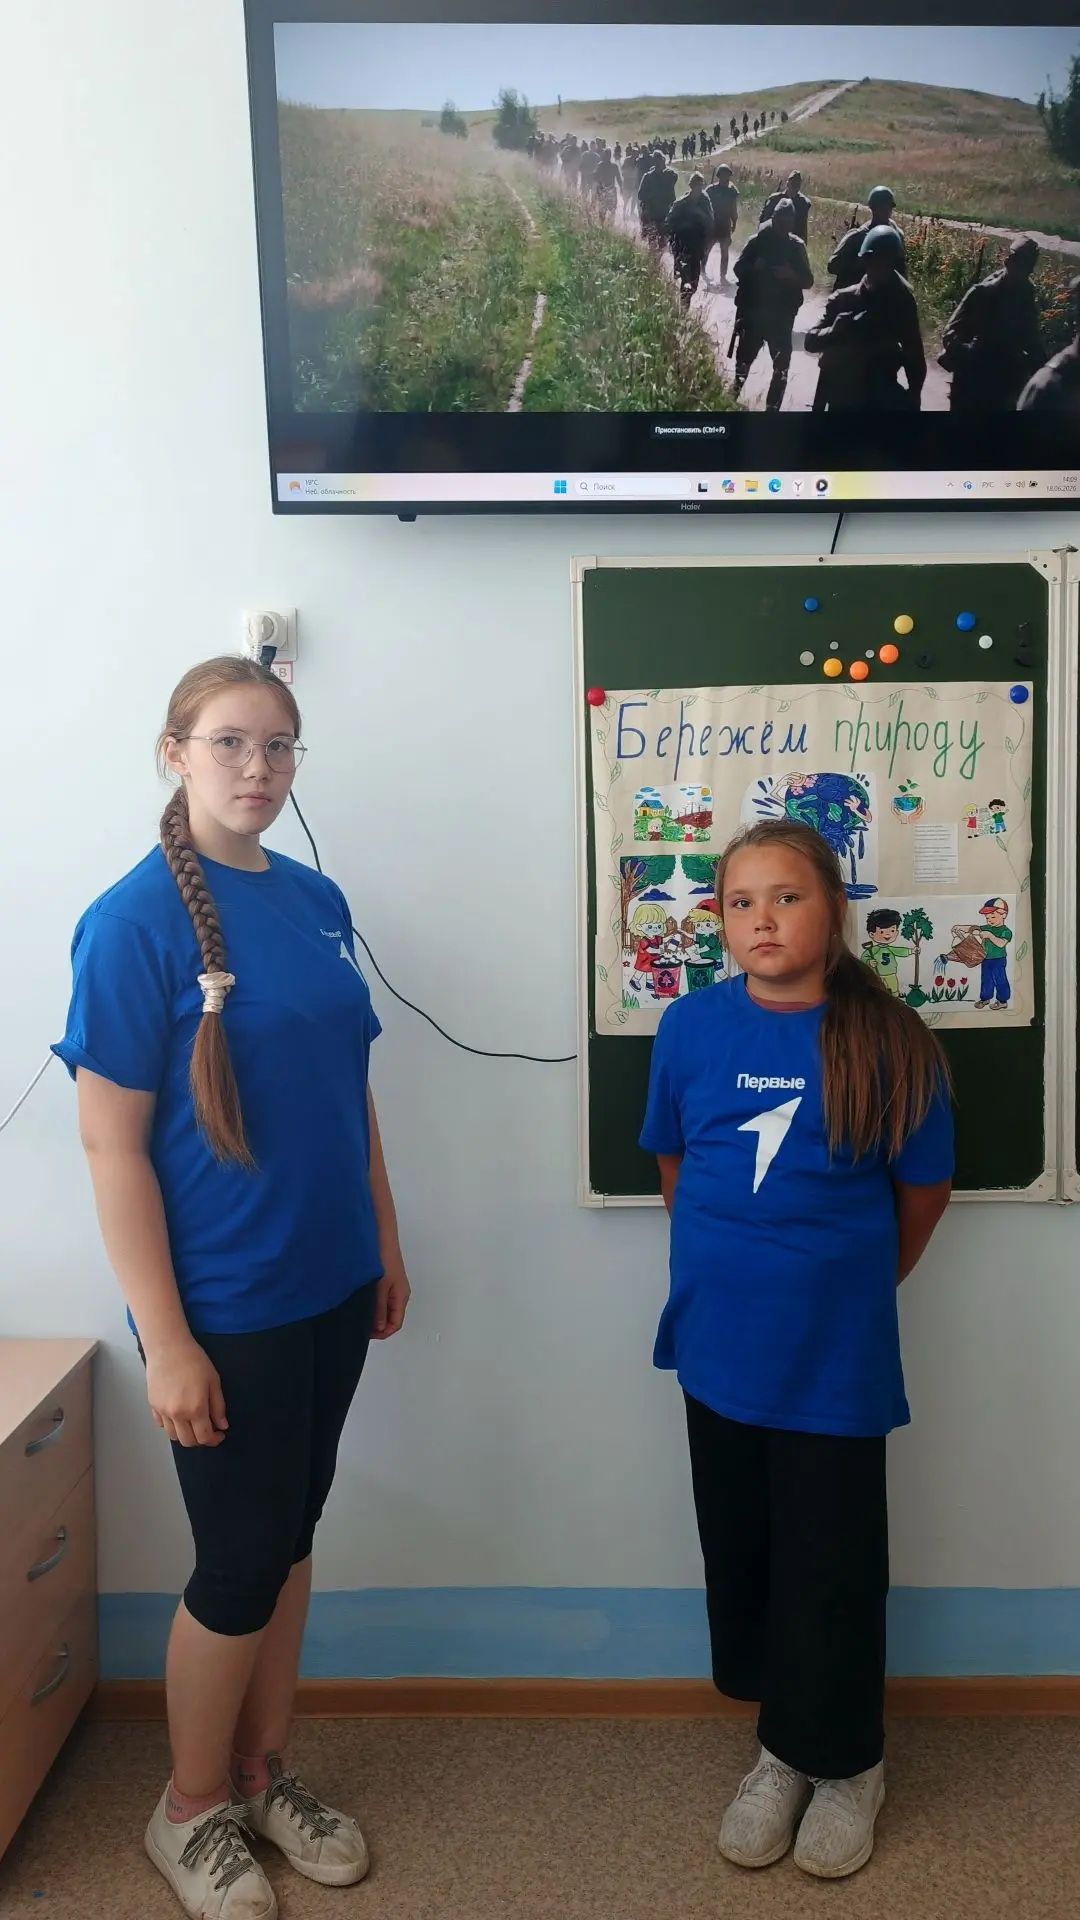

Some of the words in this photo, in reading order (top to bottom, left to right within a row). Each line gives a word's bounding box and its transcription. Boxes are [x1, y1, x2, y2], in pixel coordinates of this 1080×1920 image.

[654, 426, 702, 434] Приостановить
[593, 483, 616, 491] Поиск
[680, 502, 701, 510] Haier
[616, 702, 808, 780] Бережём
[834, 701, 986, 780] природу
[881, 953, 892, 968] 5
[736, 1073, 806, 1093] Первые
